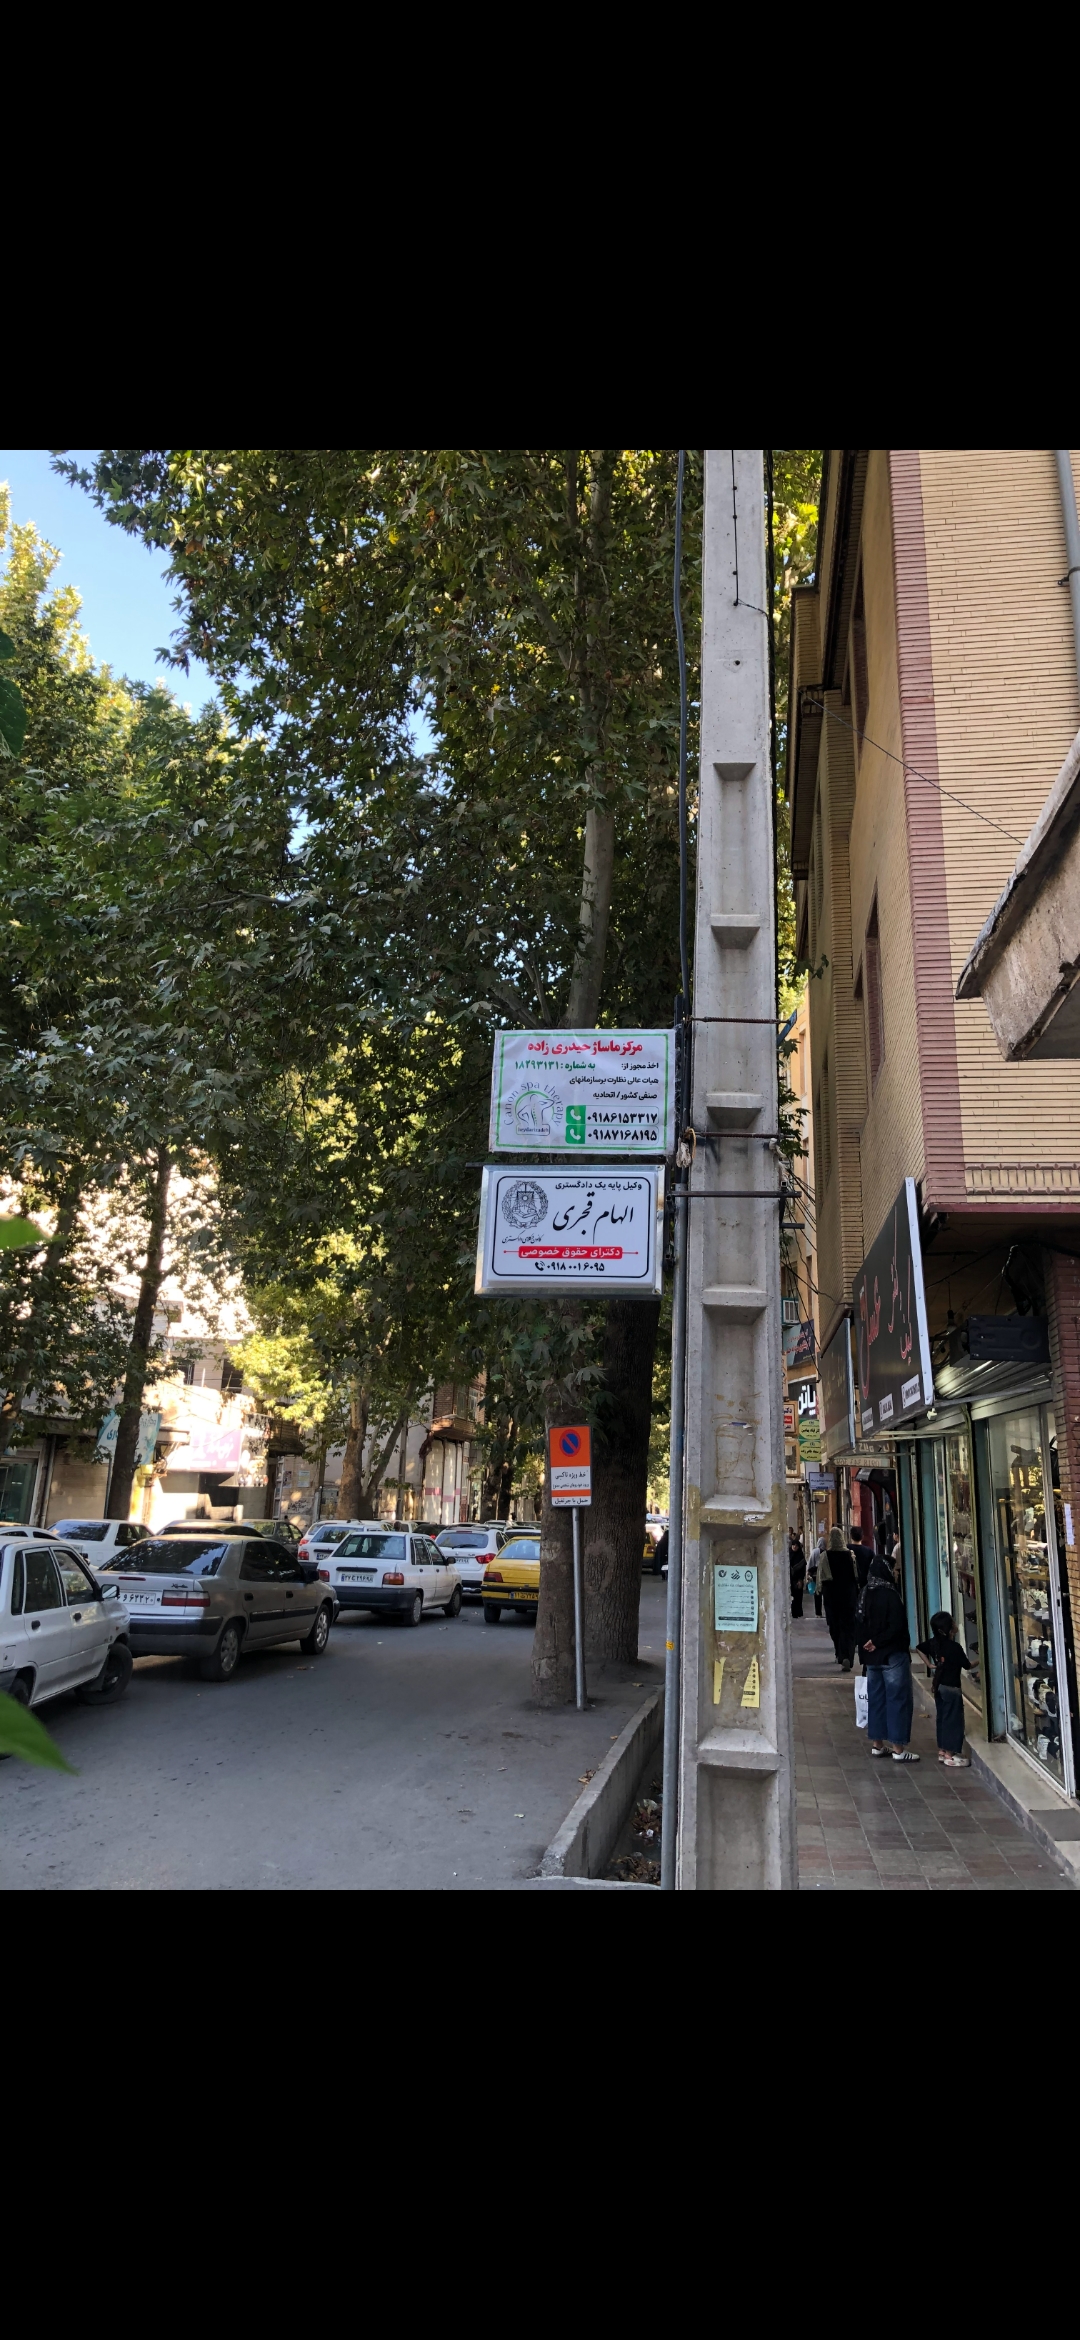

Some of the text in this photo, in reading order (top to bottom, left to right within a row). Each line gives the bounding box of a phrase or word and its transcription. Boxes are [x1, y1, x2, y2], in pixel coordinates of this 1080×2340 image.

[527, 1039, 643, 1056] مرکز ماساژ حیدری زاده
[587, 1062, 596, 1071] به
[629, 1062, 646, 1071] مجوز
[606, 1076, 627, 1085] نظارت
[627, 1077, 641, 1085] عالی
[592, 1090, 616, 1100] اتحادیه
[620, 1091, 639, 1100] کشور
[638, 1091, 658, 1100] صنفی
[555, 1180, 643, 1191] وکیل پایه یک دادگستری
[592, 1203, 634, 1245] الهام
[520, 1247, 620, 1258] دکترای حقوق خصوصی
